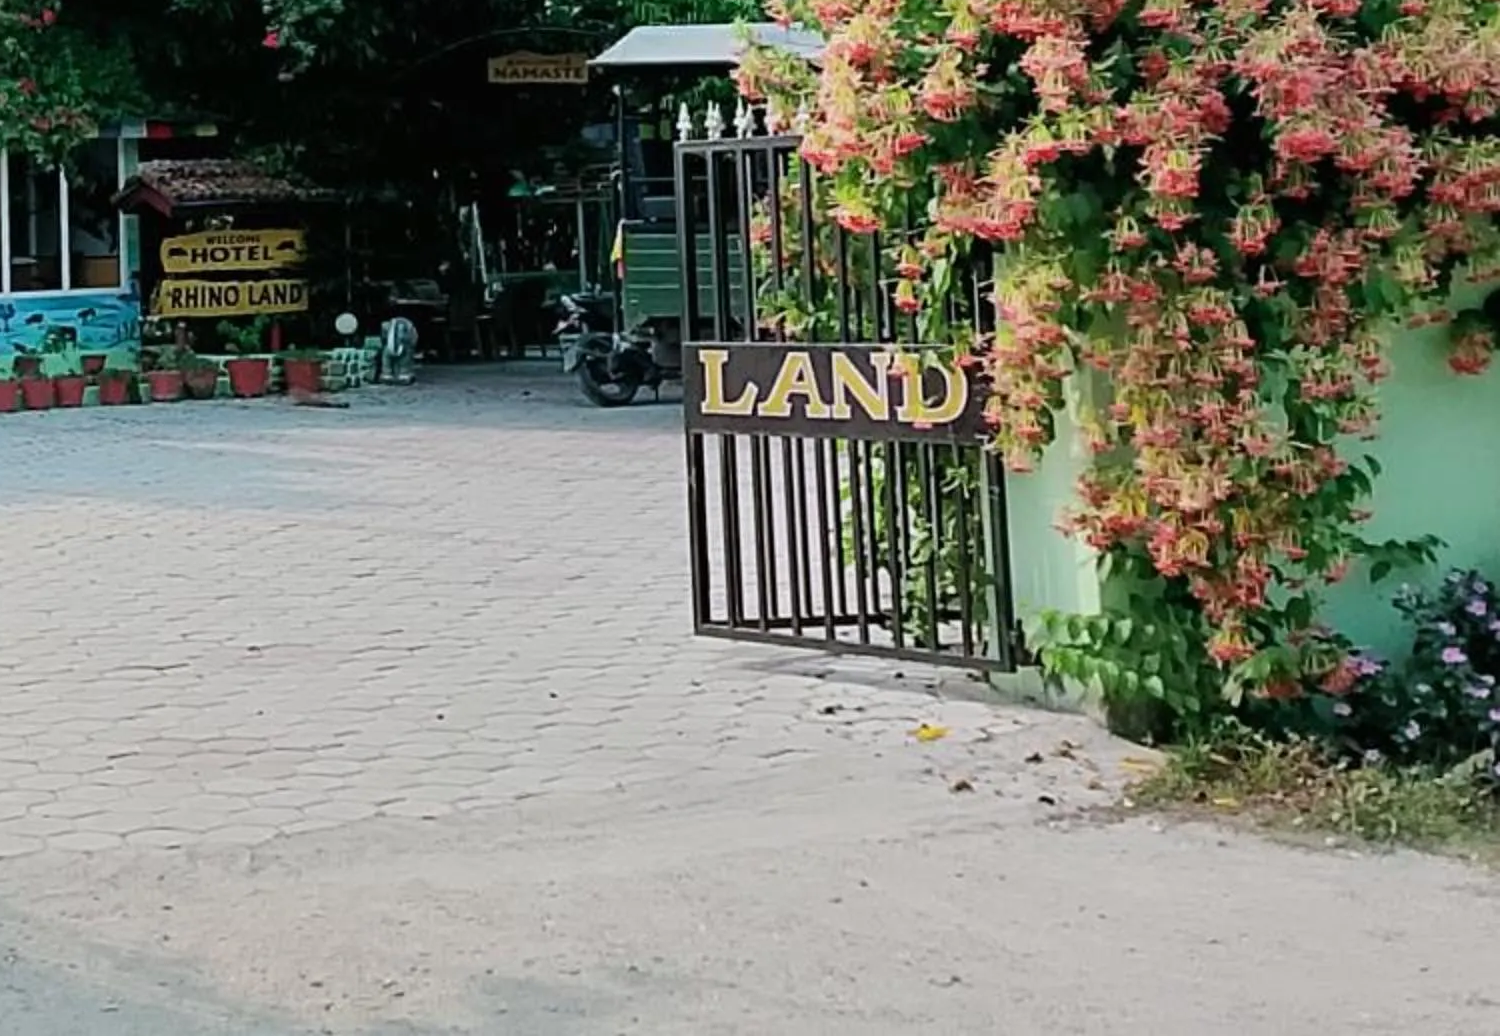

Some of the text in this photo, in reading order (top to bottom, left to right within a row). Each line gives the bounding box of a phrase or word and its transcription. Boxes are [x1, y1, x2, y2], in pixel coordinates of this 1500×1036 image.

[493, 67, 584, 79] NAMASTE
[191, 245, 274, 263] HOTEL
[170, 283, 302, 309] RHINO LAND
[699, 349, 969, 423] LAND
